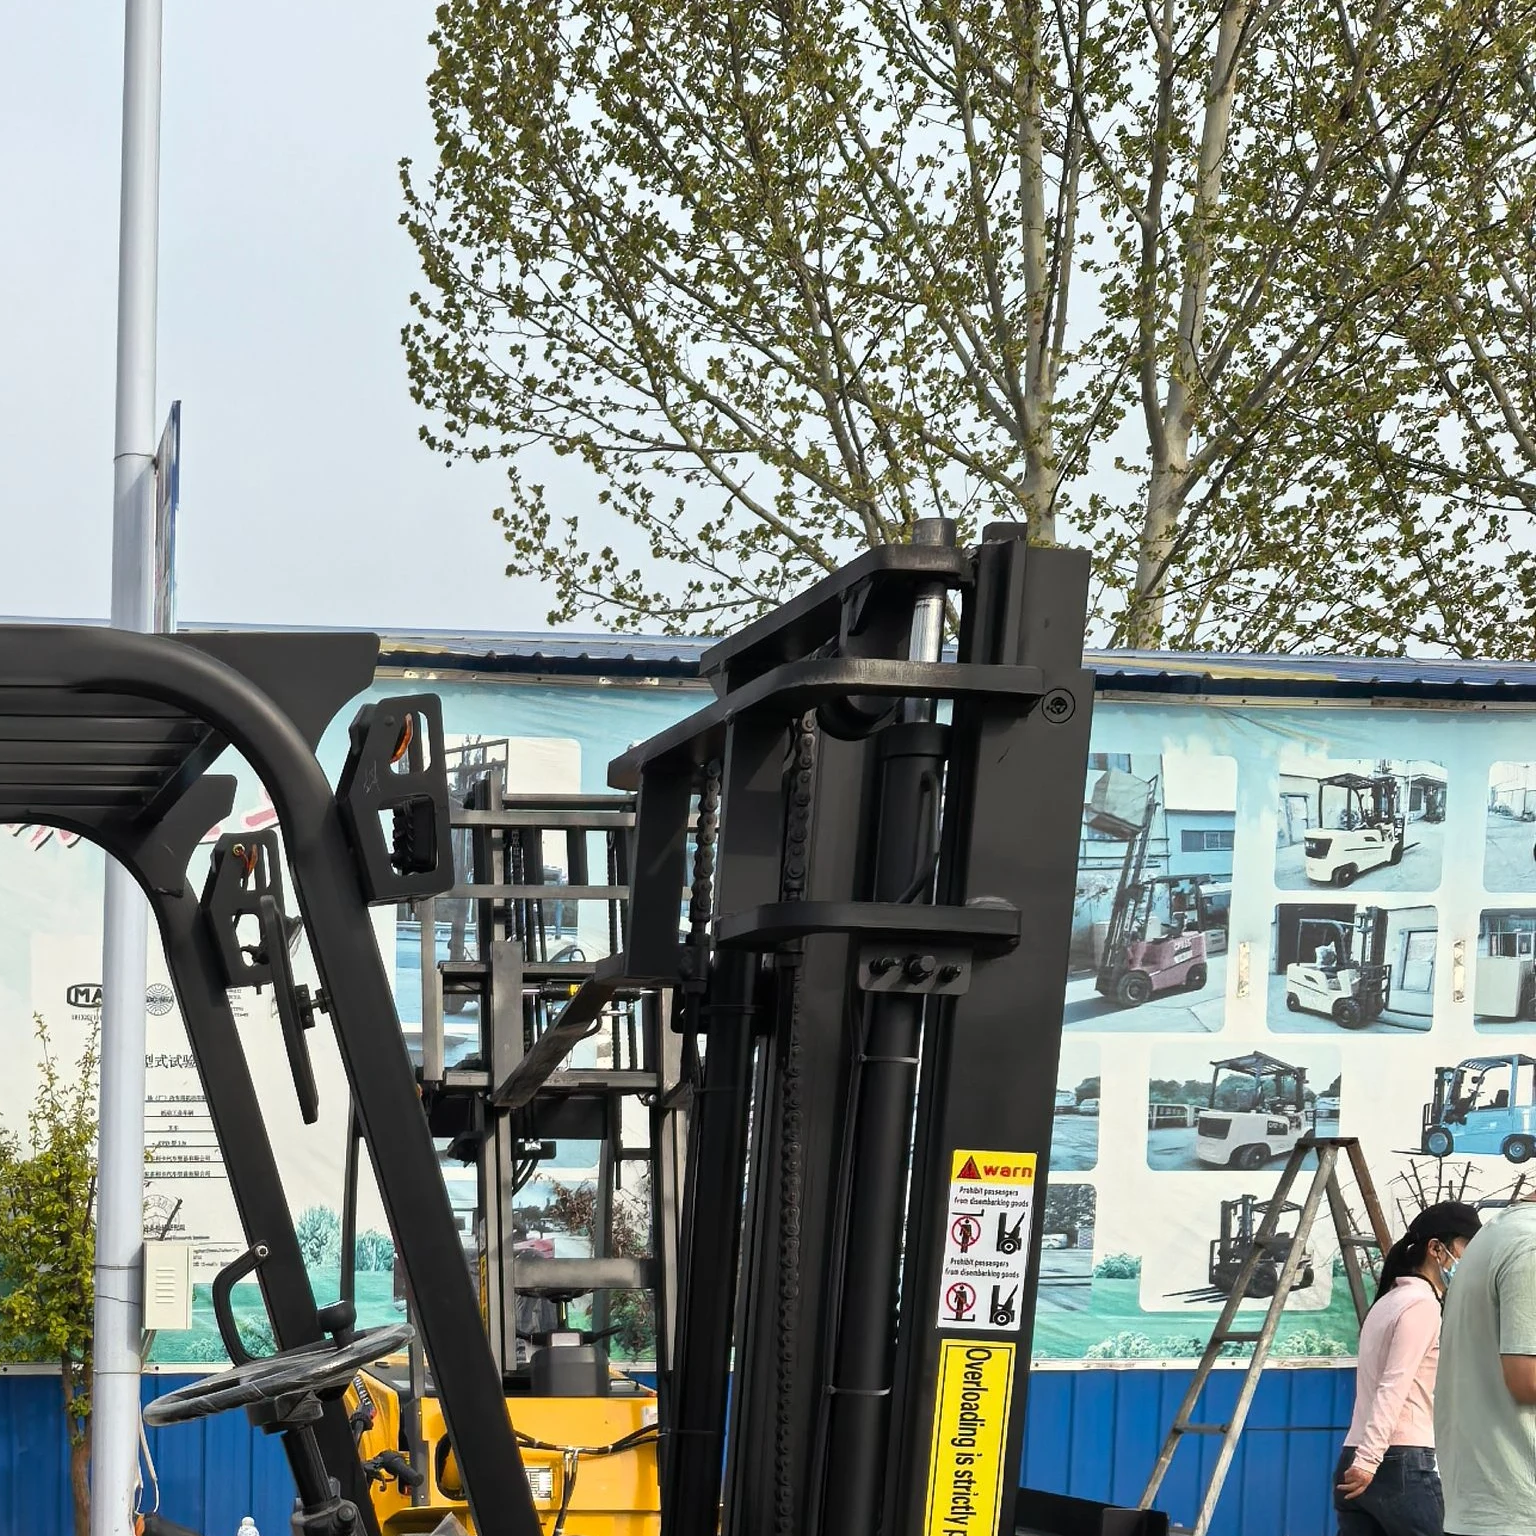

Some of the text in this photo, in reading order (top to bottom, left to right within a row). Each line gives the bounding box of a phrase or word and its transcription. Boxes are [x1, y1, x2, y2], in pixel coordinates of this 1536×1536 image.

[983, 1165, 1032, 1178] warn
[959, 1186, 1019, 1197] Prohibit passengers
[954, 1197, 1029, 1208] from disembarking goods
[950, 1257, 1009, 1268] Prohibit passengers
[945, 1267, 1020, 1279] from disembarking goods
[951, 1347, 992, 1448] Overloading
[954, 1452, 983, 1466] is
[943, 1469, 979, 1526] strictly
